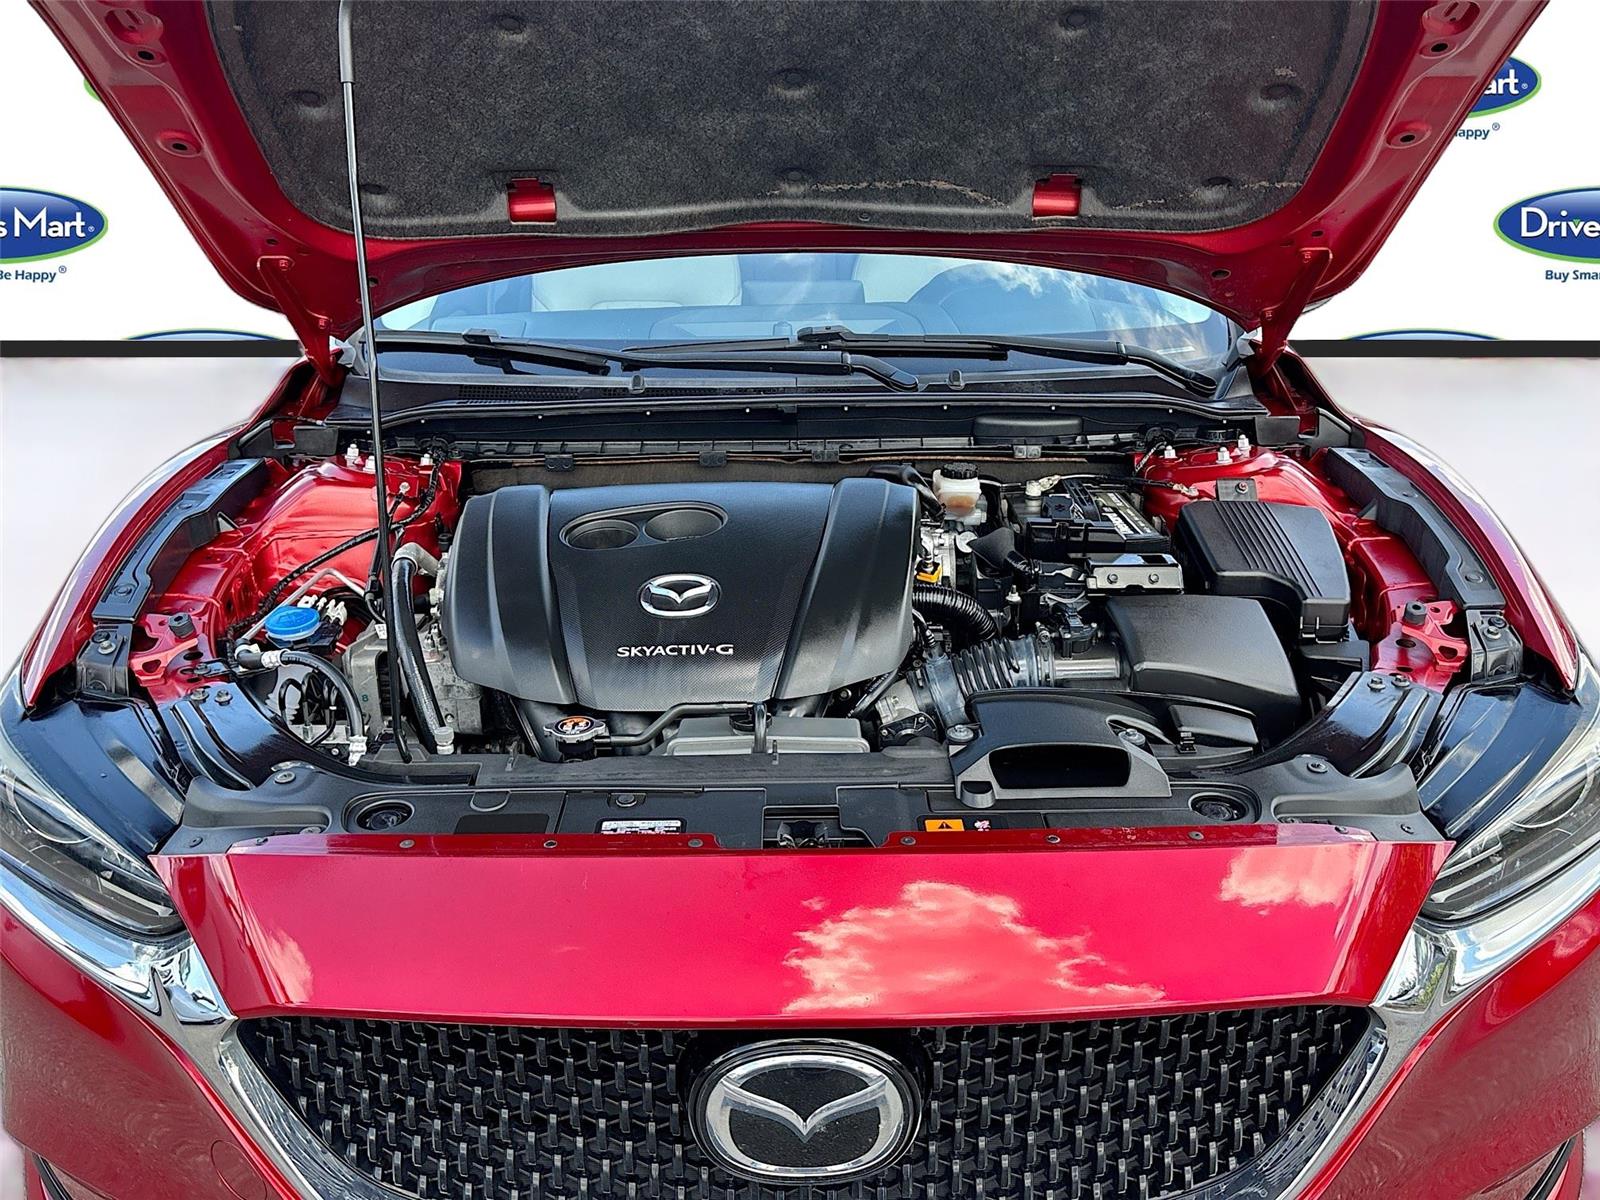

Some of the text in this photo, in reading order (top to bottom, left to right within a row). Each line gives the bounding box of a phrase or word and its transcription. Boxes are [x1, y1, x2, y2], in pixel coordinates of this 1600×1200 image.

[1484, 69, 1520, 95] art
[1455, 128, 1490, 140] appy
[14, 206, 86, 238] Mart
[15, 269, 57, 283] Happy
[1545, 269, 1569, 283] Buy
[616, 643, 734, 658] SKYACTIV-G
